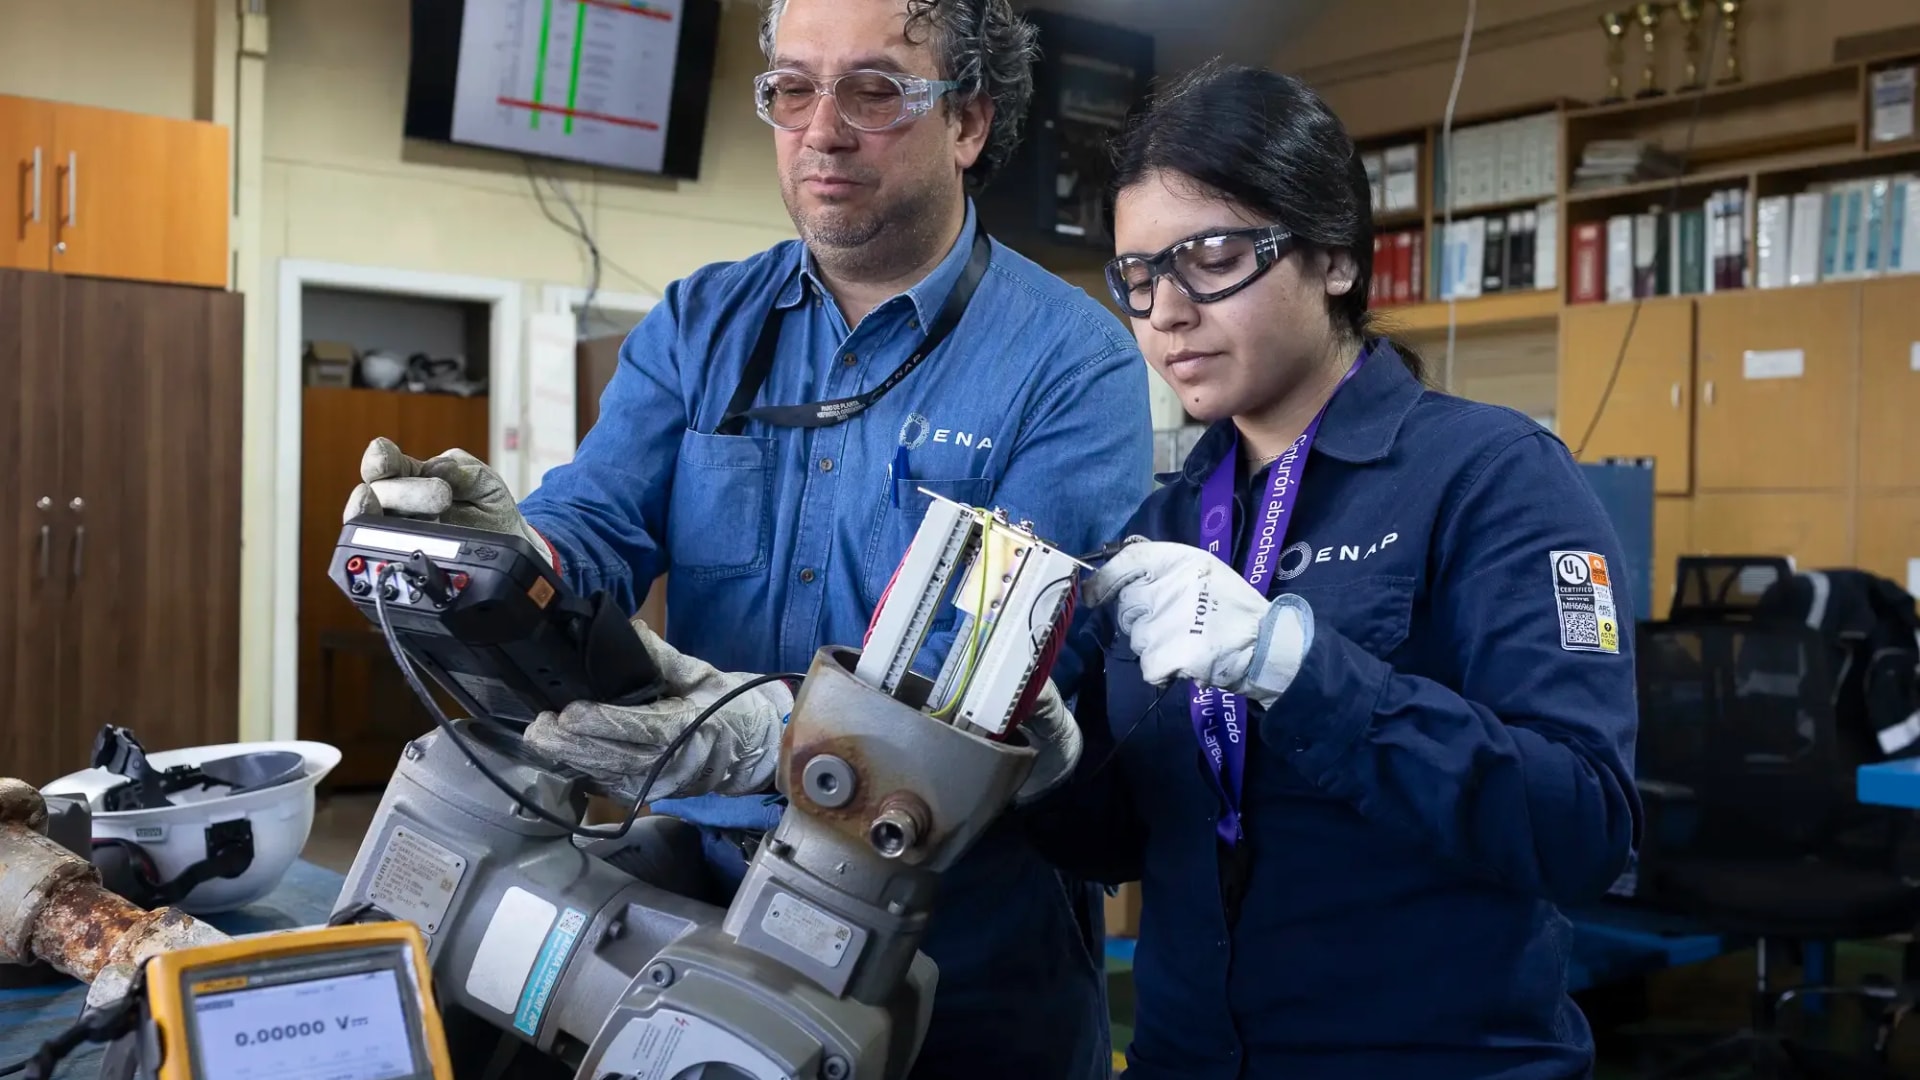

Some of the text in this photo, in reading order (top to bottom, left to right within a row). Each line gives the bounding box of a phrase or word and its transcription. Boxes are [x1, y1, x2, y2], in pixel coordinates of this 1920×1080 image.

[885, 353, 921, 388] ENAP
[1249, 433, 1307, 585] Cinturón abrochado
[1315, 532, 1399, 563] ENAP
[1563, 560, 1584, 581] UL
[1218, 688, 1241, 743] urado
[534, 968, 558, 1010] SUPPORT
[235, 1015, 350, 1047] 0.00000 V
